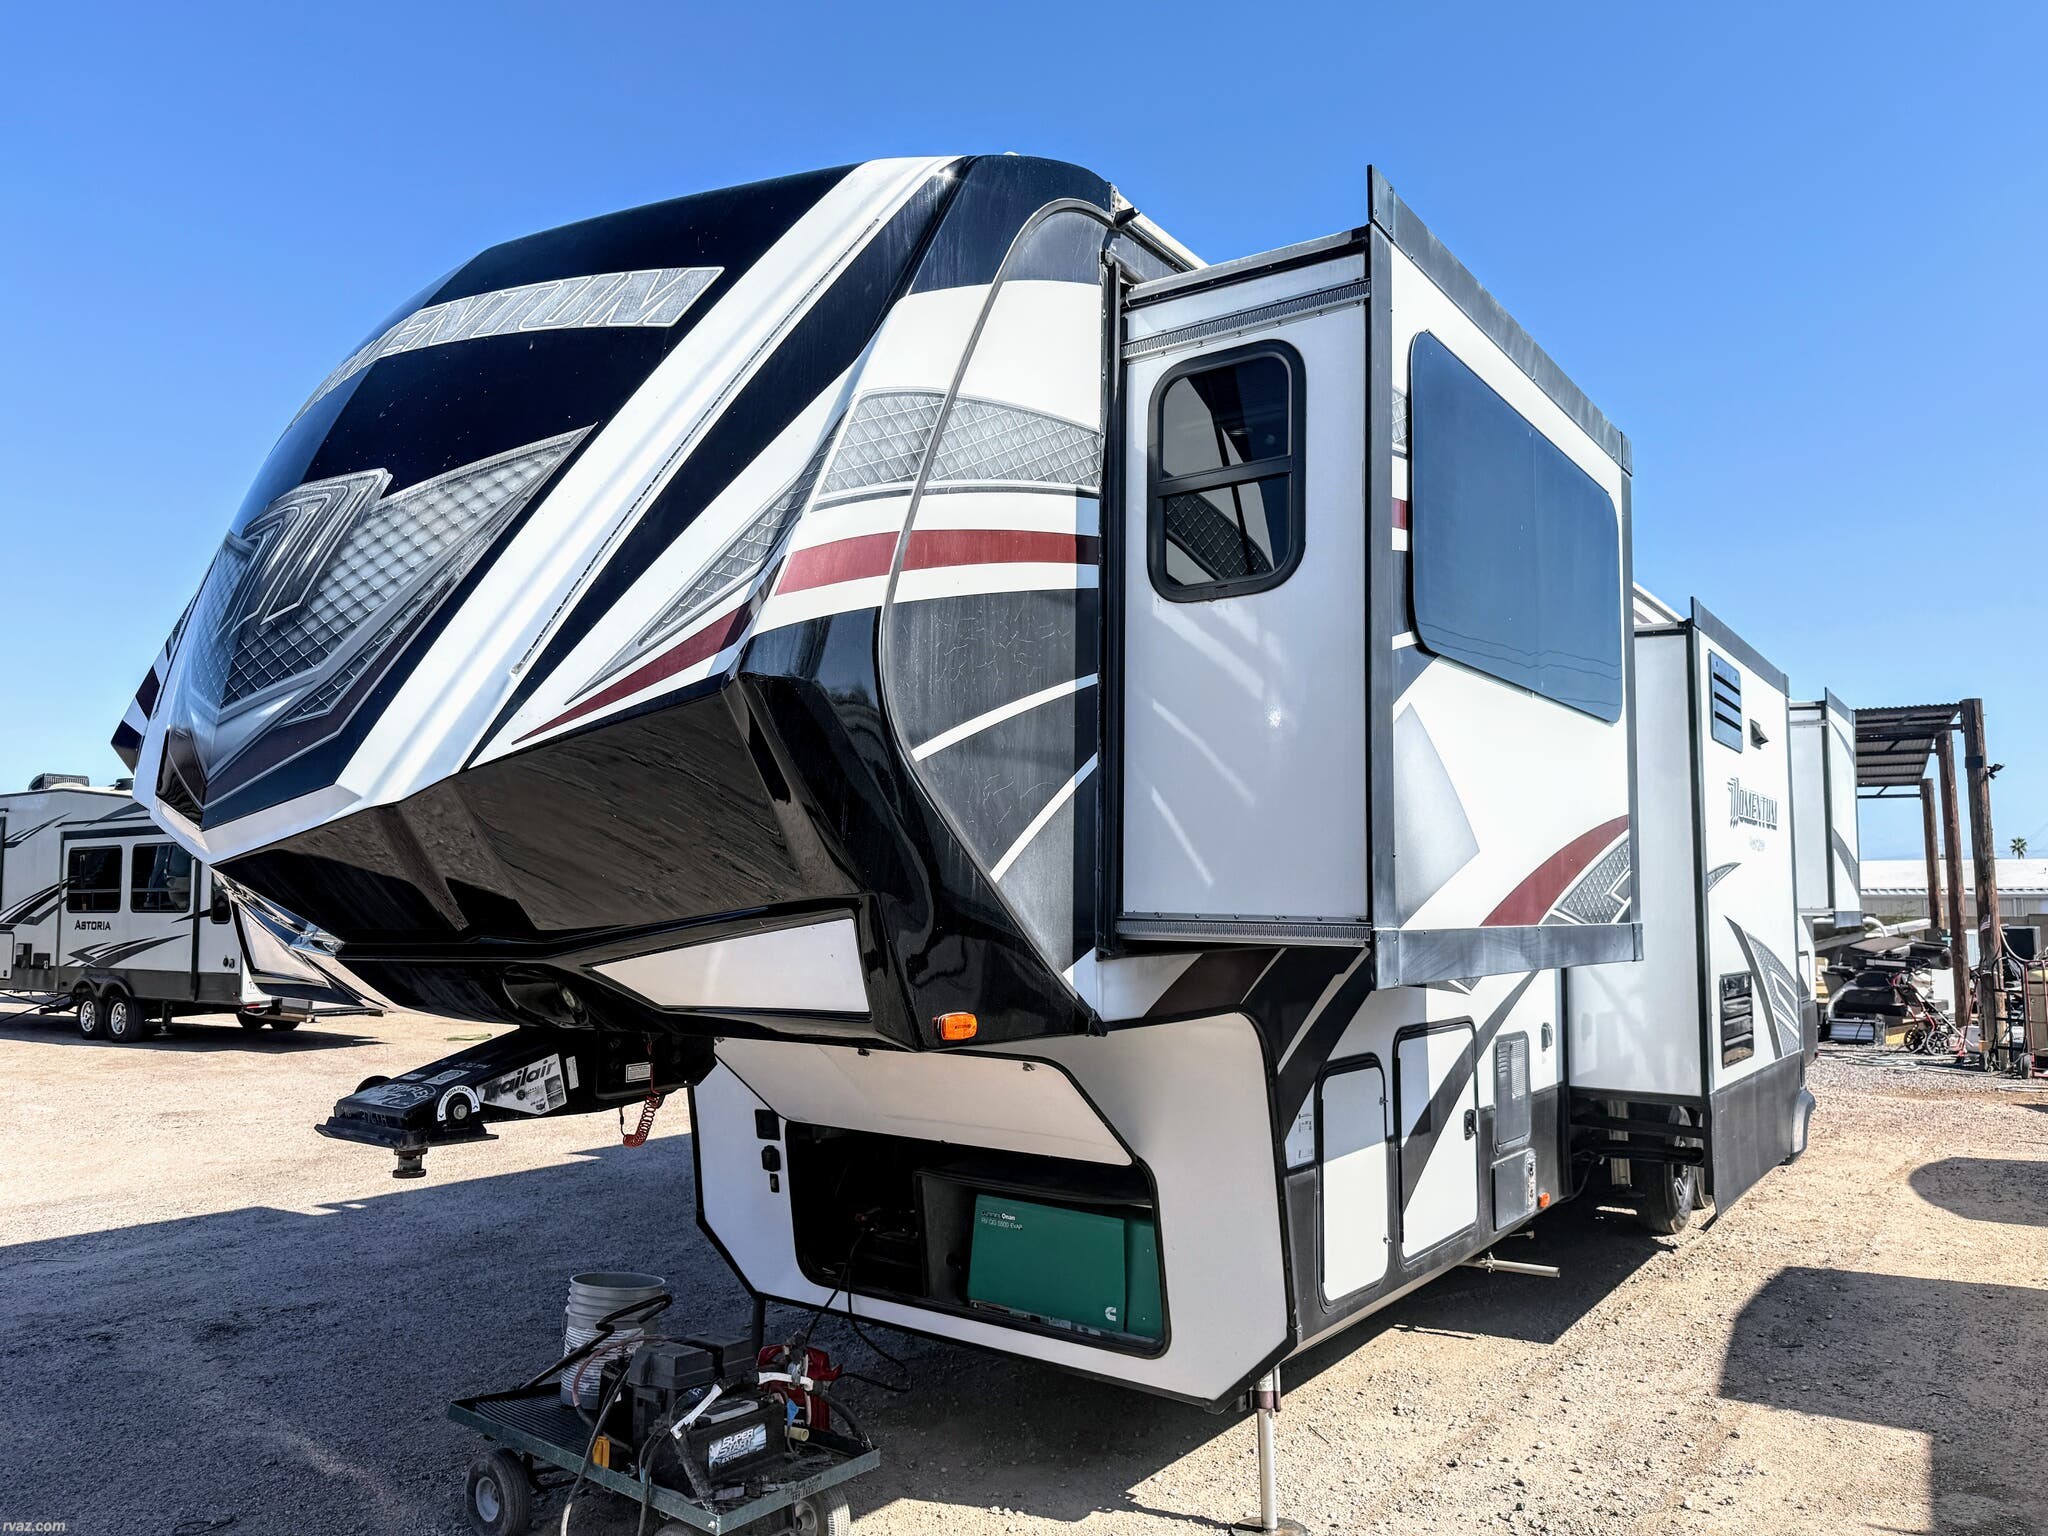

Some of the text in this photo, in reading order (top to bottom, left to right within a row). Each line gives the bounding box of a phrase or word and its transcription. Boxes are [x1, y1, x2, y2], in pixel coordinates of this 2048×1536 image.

[74, 919, 111, 931] ASTORIA
[1002, 1213, 1016, 1221] Onan
[722, 1428, 754, 1447] SUPER
[718, 1438, 752, 1457] START
